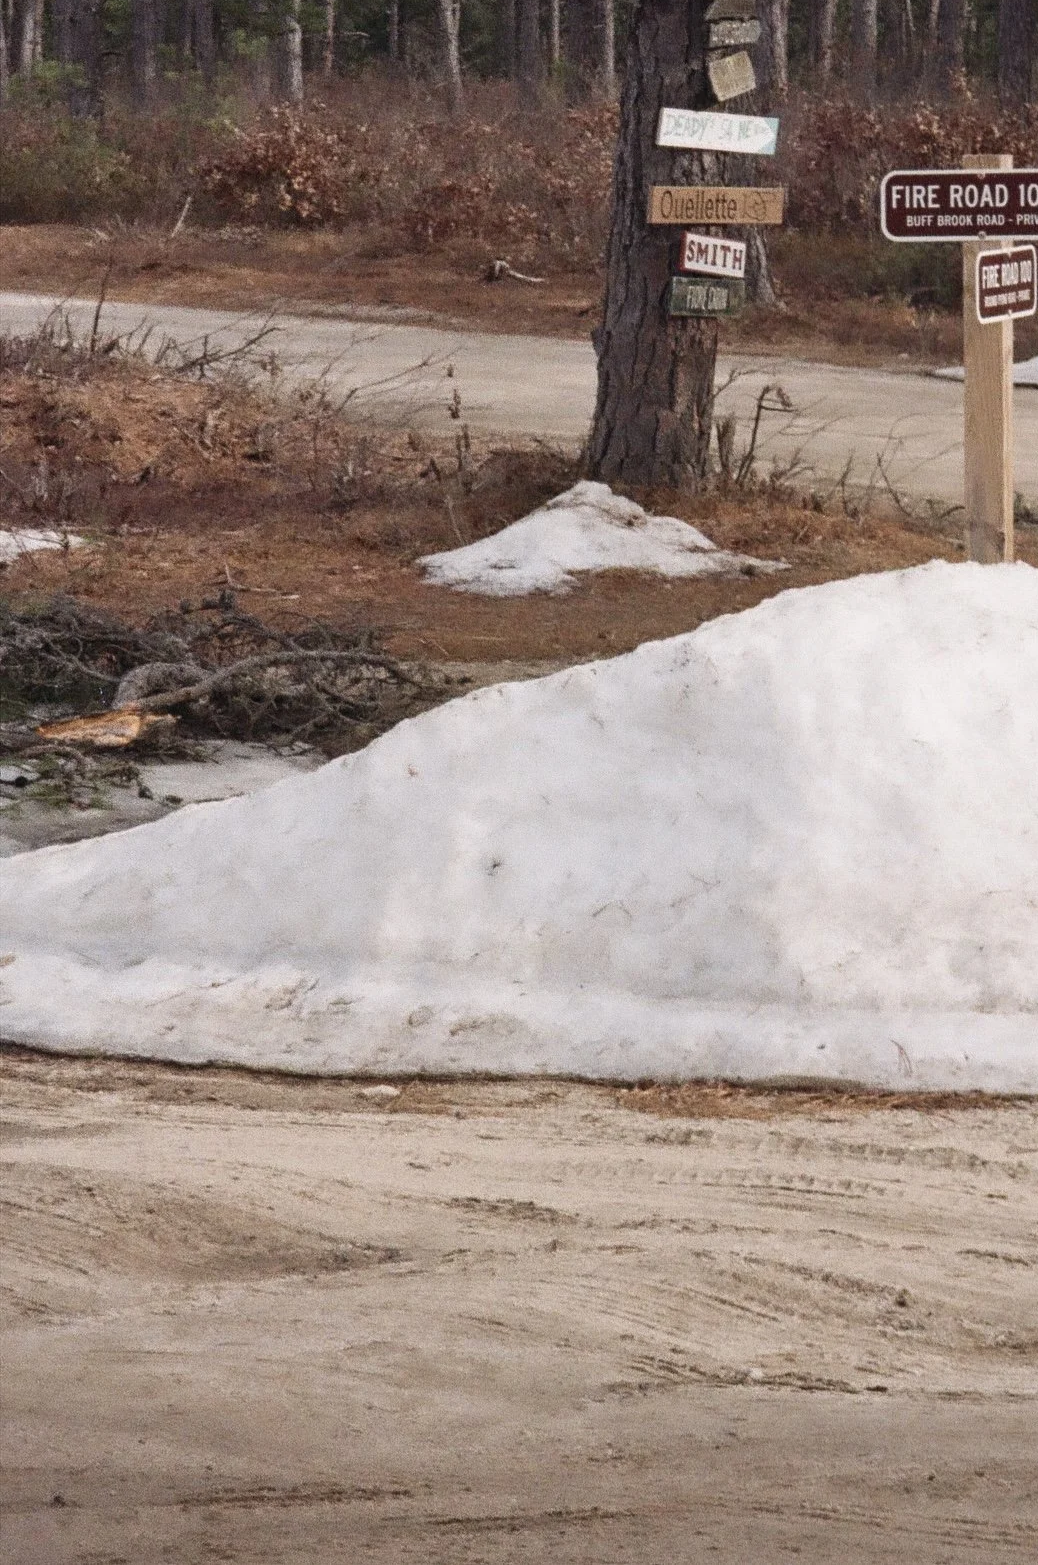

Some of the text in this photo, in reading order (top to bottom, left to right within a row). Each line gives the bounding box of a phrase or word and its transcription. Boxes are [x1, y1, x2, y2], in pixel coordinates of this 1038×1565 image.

[661, 190, 737, 219] Ouellette
[891, 185, 941, 209] FIRE
[949, 184, 1009, 208] ROAD
[906, 214, 933, 227] BUFF
[937, 213, 973, 227] BROOK
[976, 213, 1005, 226] ROAD
[686, 241, 742, 270] SMITH
